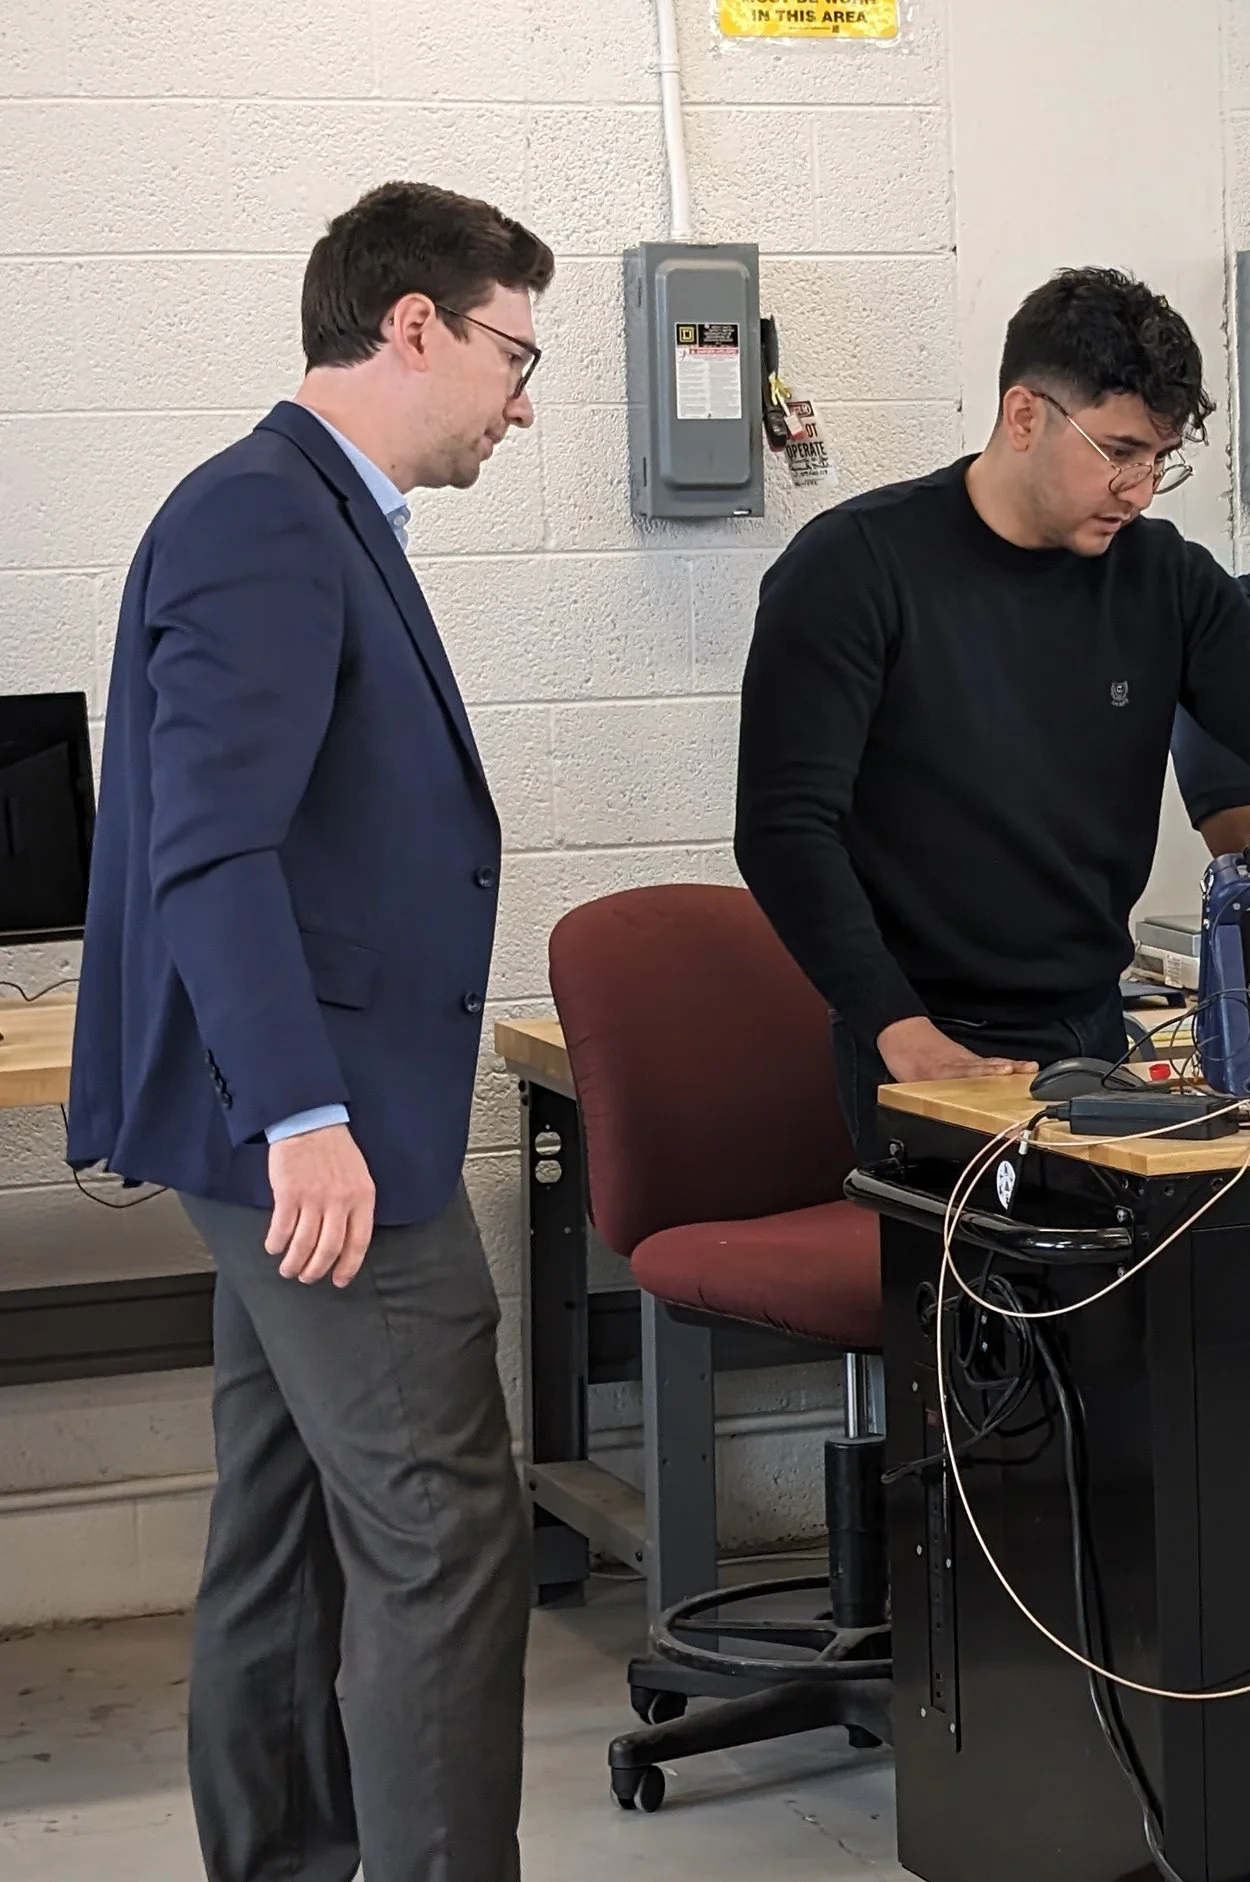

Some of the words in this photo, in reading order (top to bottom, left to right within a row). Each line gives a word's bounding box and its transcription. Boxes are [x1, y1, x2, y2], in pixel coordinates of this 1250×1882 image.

[752, 9, 770, 21] IN
[775, 10, 817, 22] THIS
[822, 10, 868, 23] AREA
[785, 441, 827, 459] OPERATE
